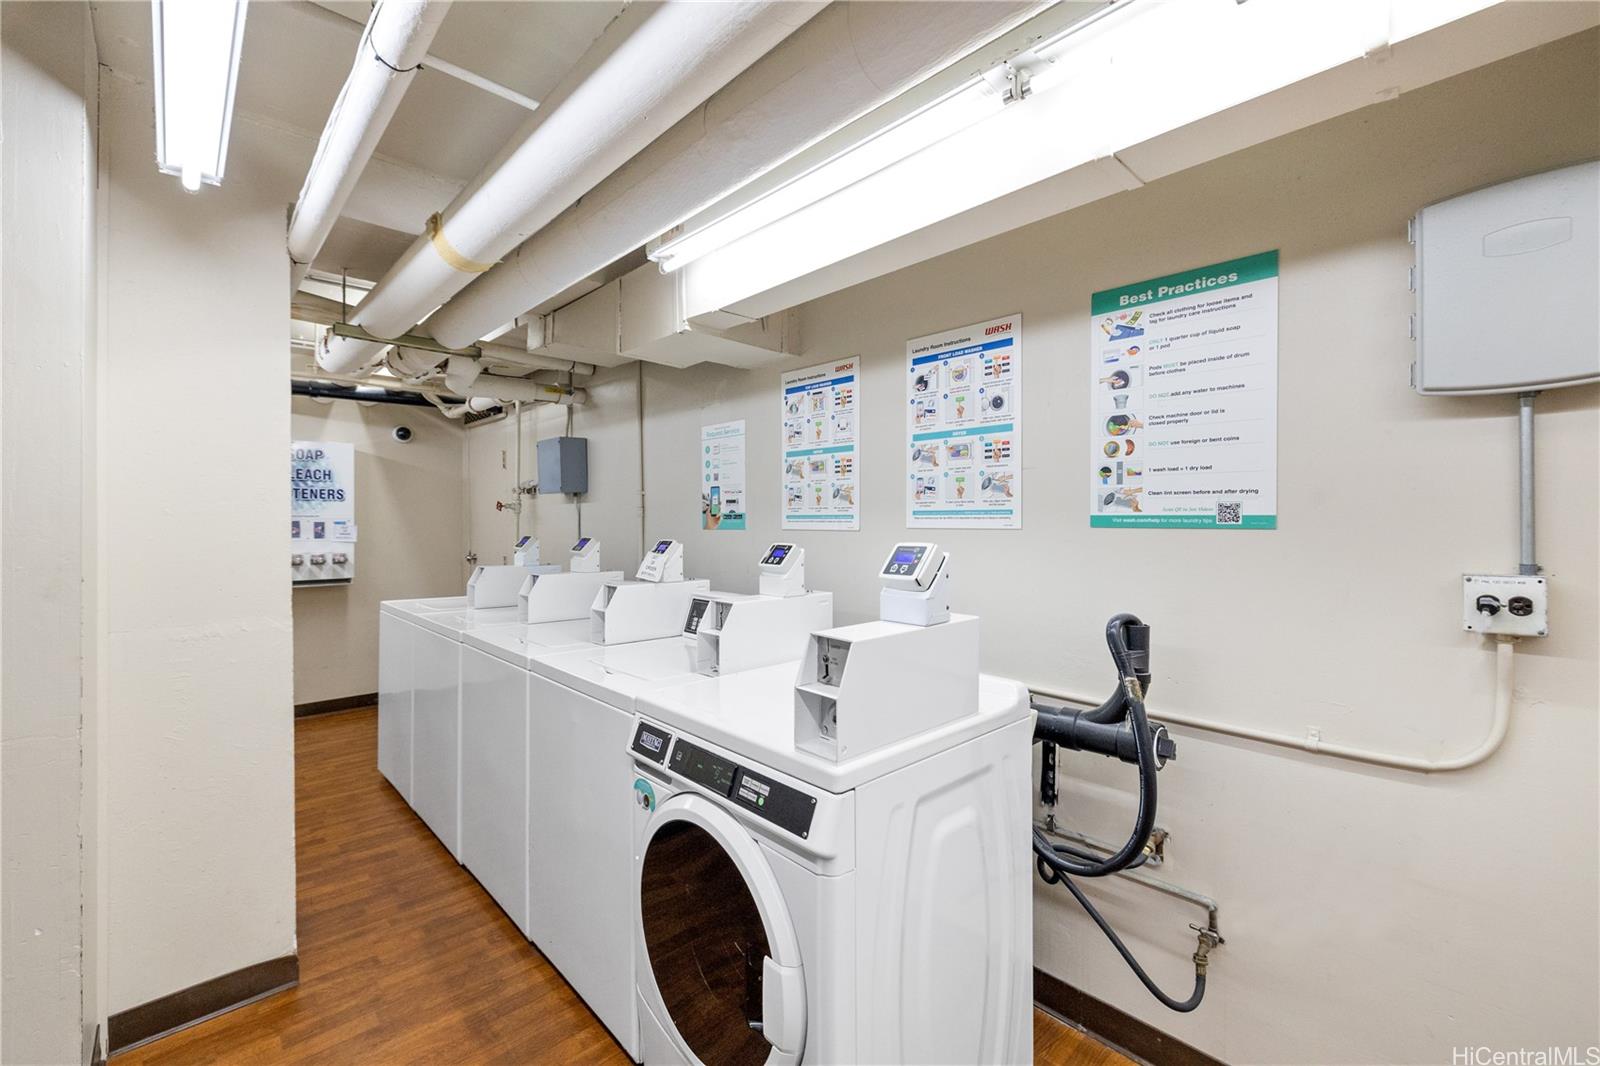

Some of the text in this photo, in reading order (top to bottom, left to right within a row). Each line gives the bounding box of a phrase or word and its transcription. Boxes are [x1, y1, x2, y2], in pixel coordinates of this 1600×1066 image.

[1120, 272, 1238, 306] Best Practices
[1167, 313, 1187, 321] laundry
[1202, 304, 1236, 314] instructions
[1174, 305, 1196, 314] clothing
[985, 322, 1012, 336] WASH
[1169, 334, 1188, 342] quarter
[1208, 327, 1225, 335] liquid
[944, 337, 971, 347] Instructions
[938, 352, 952, 360] FRONT
[964, 346, 983, 354] WASHER
[1216, 383, 1245, 391] machines
